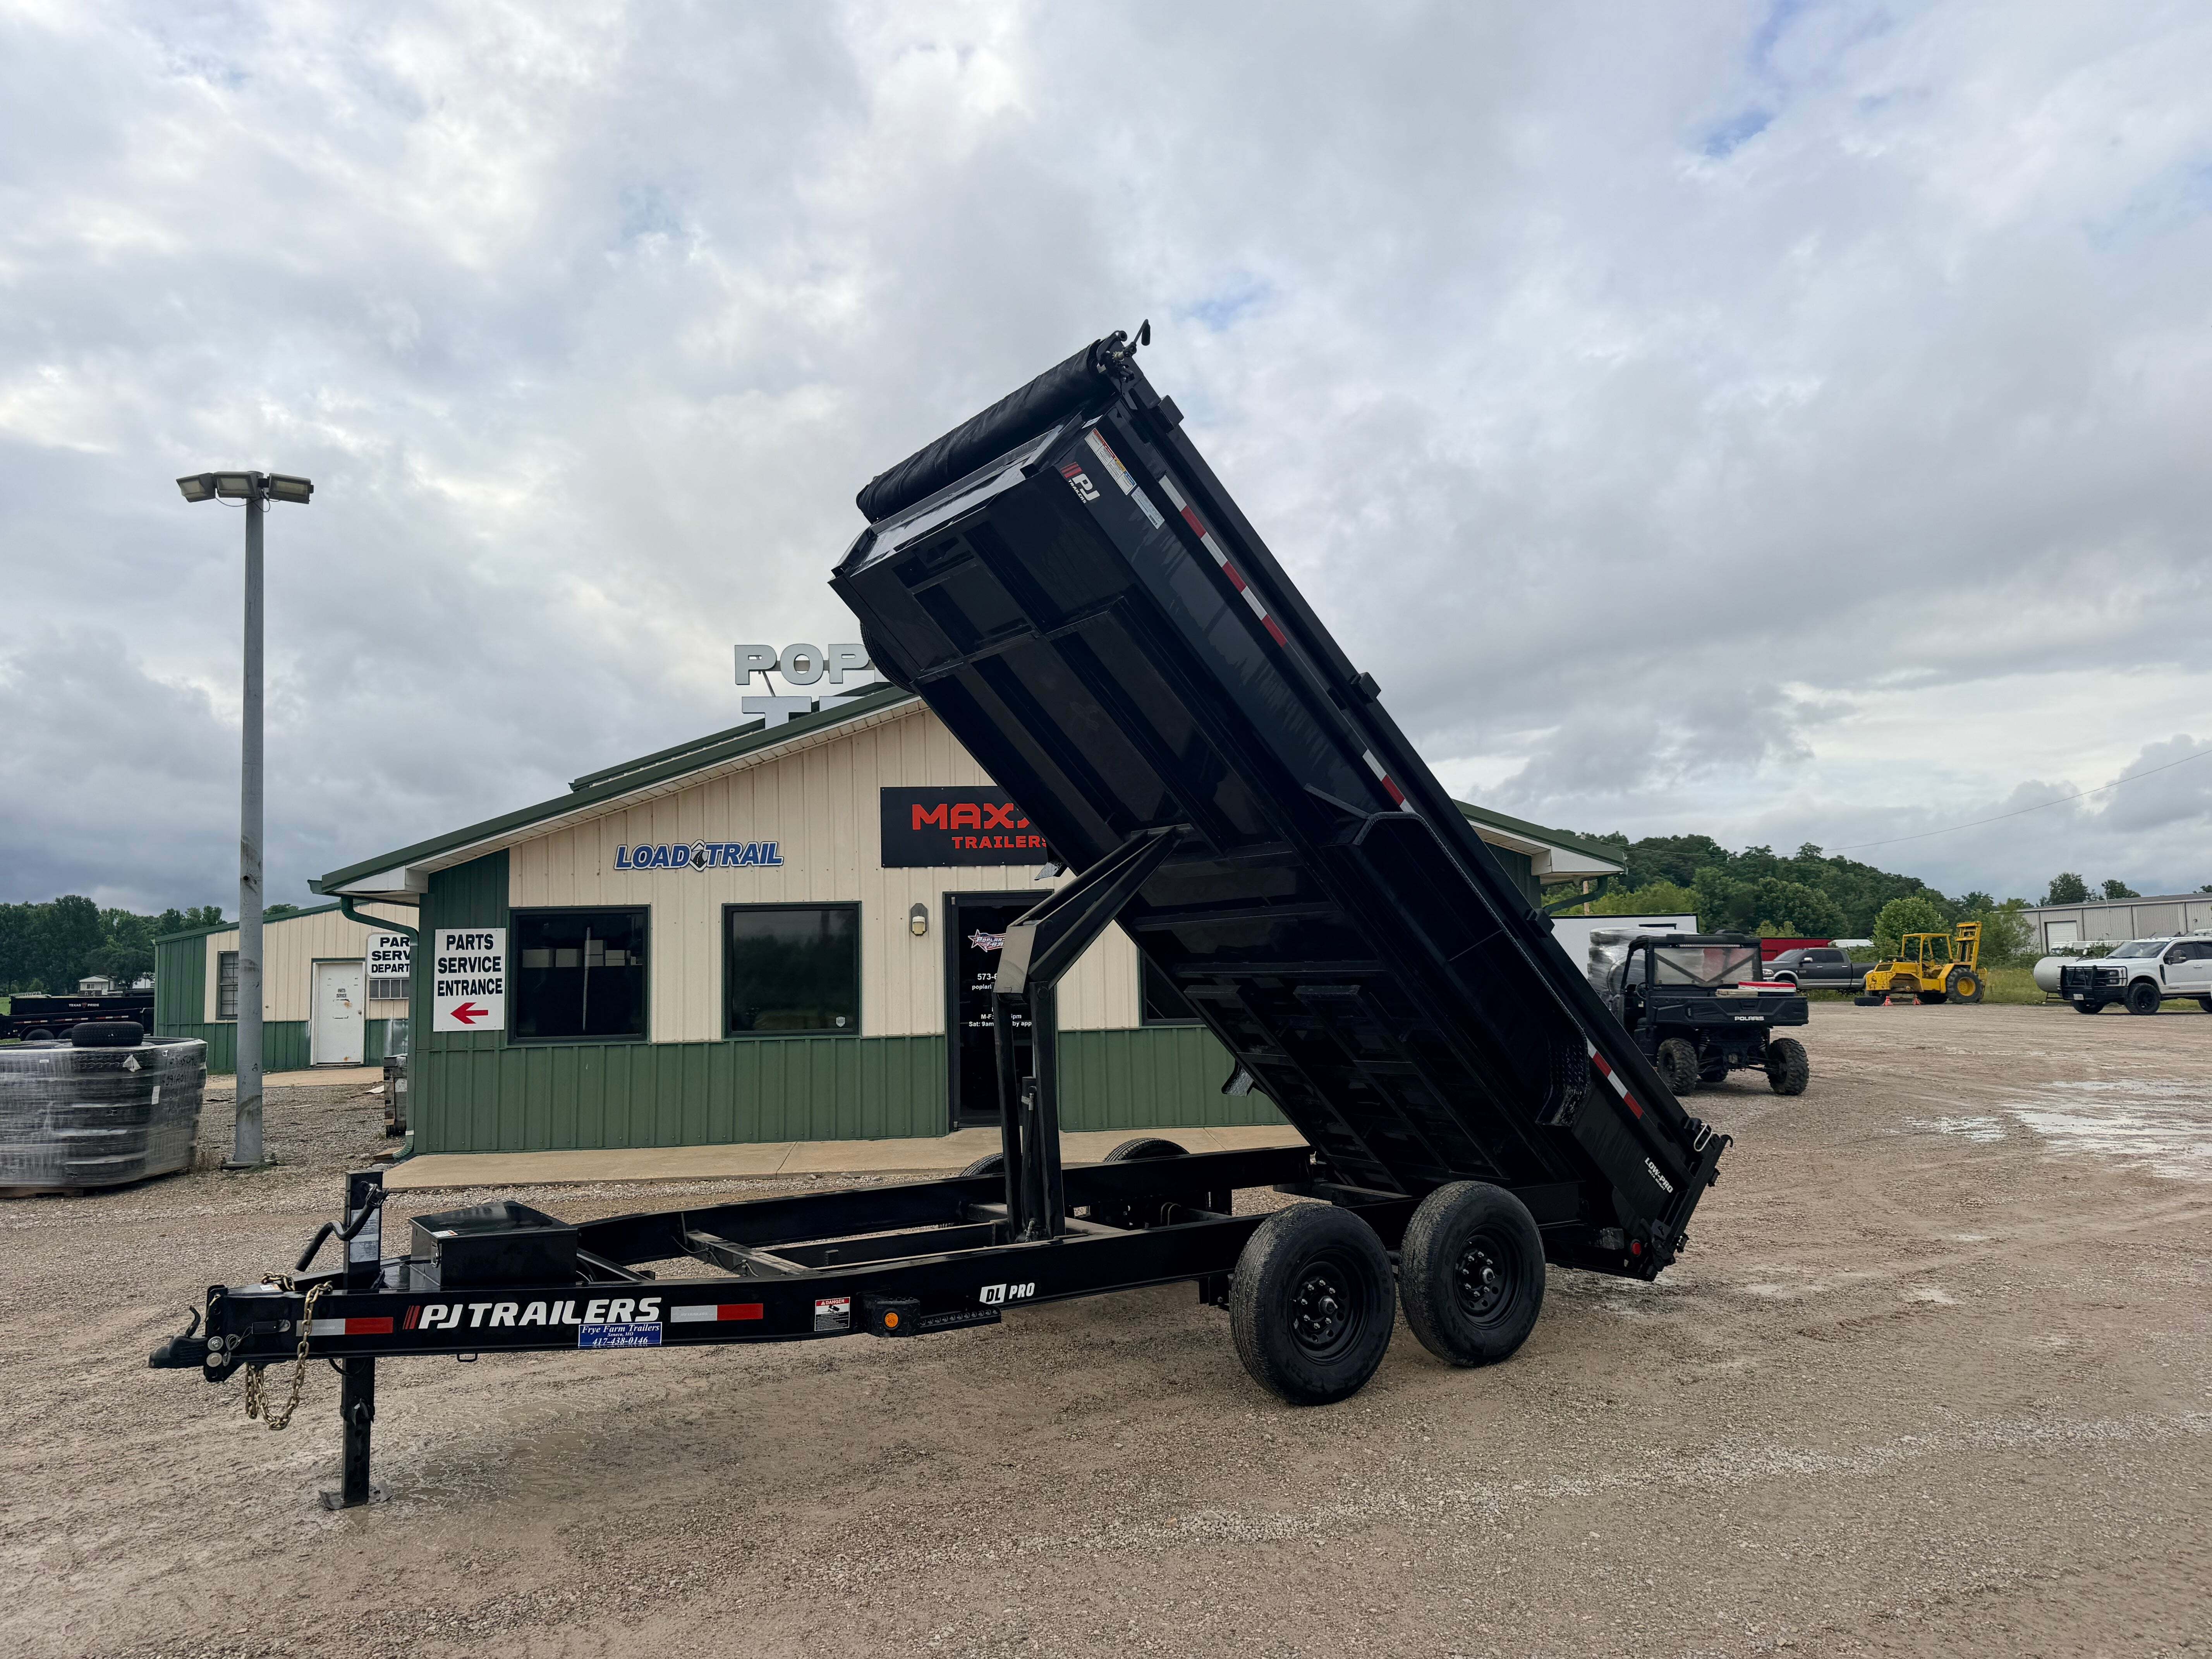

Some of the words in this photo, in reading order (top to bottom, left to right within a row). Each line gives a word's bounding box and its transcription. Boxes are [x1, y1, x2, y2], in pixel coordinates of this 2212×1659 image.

[1068, 479, 1087, 504] TRAILERS
[1072, 473, 1100, 501] PJ
[735, 644, 891, 685] POP
[912, 803, 1030, 830] MAX
[615, 843, 692, 869] LOAD
[705, 842, 784, 867] TRAIL
[380, 937, 410, 947] PAR
[446, 934, 494, 951] PARTS
[372, 950, 410, 961] SERV
[438, 956, 501, 974] SERVICE
[371, 963, 410, 973] DEPART
[437, 978, 503, 996] ENTRANCE
[1645, 1157, 1673, 1193] LOW-PRO
[986, 1287, 1001, 1303] DL
[1009, 1282, 1035, 1300] PRO
[468, 1297, 662, 1328] TRAILERS
[582, 1326, 601, 1335] Frye
[603, 1324, 625, 1333] Farm
[629, 1324, 660, 1332] Trailers
[592, 1336, 648, 1346] 417-438-0146
